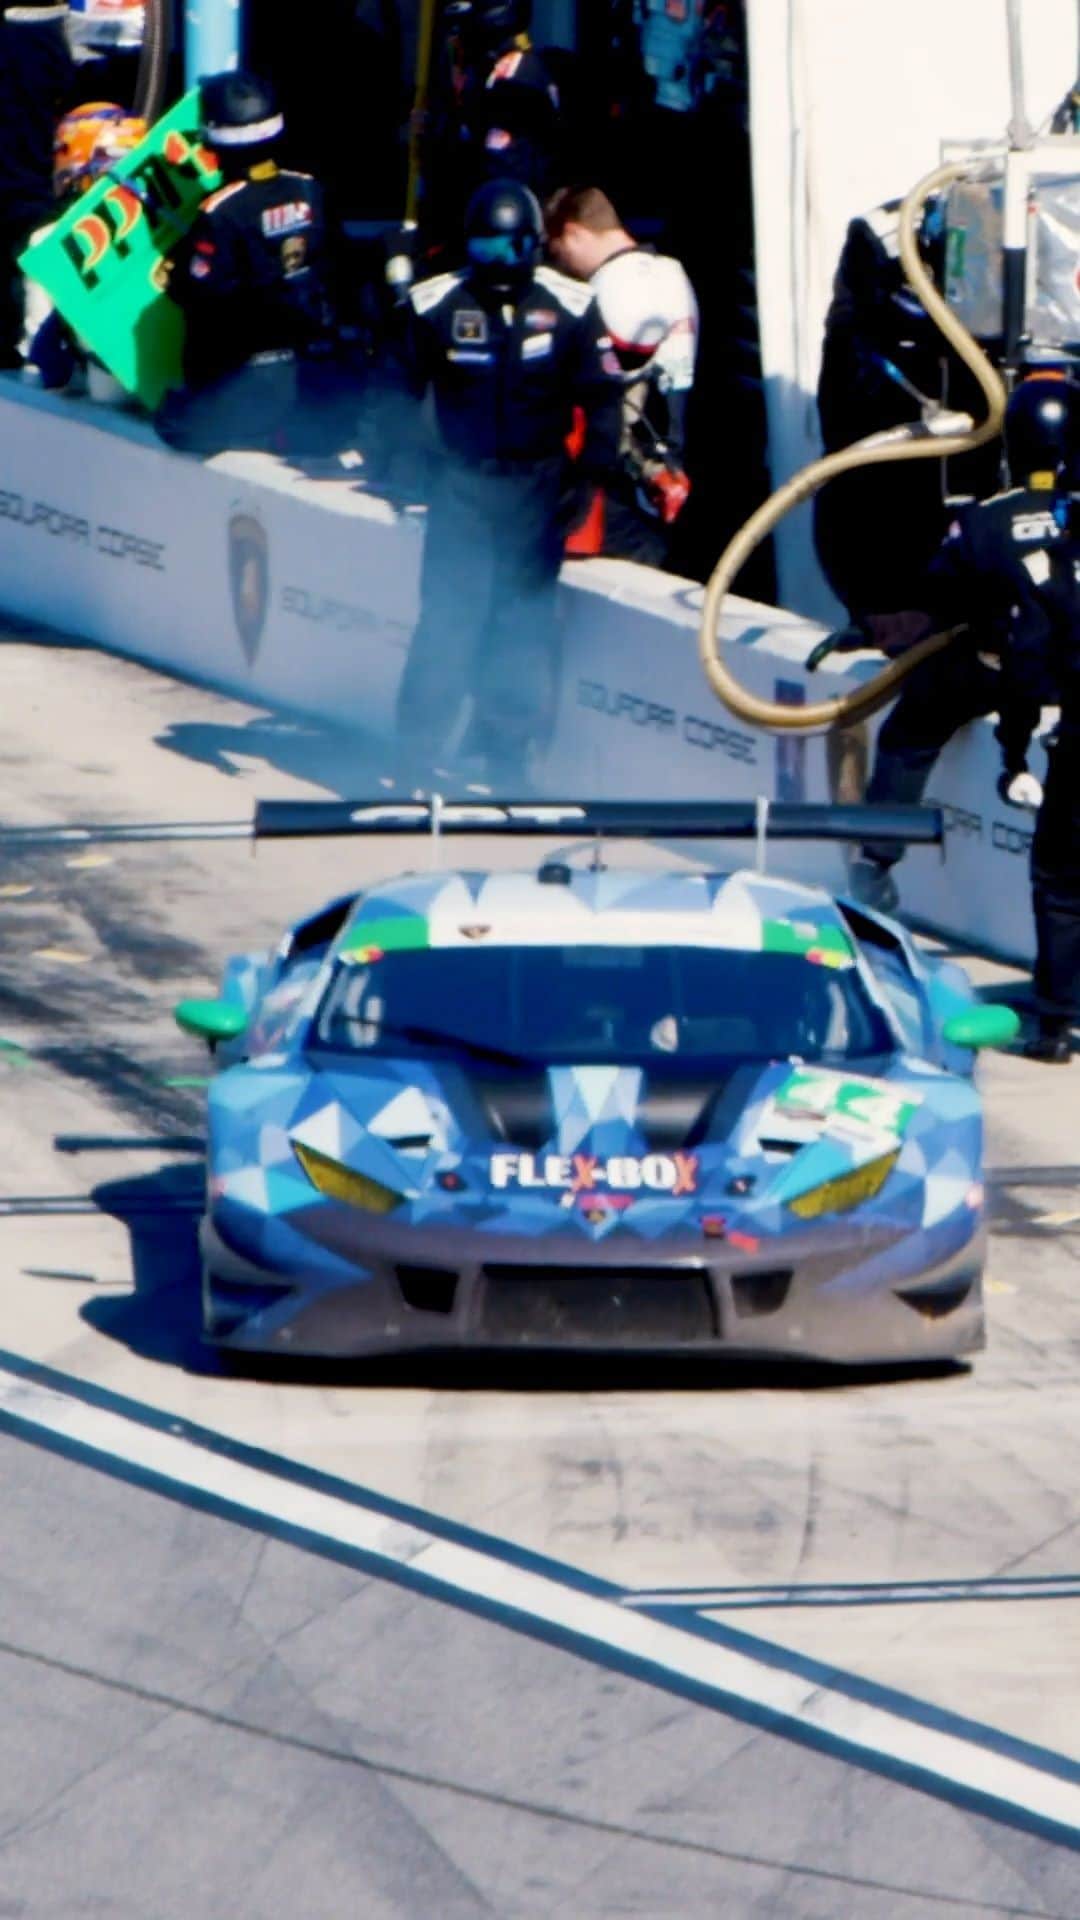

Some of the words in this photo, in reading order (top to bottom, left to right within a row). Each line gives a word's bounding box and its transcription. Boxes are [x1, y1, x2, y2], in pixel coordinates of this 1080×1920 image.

[683, 714, 758, 766] CORSE
[991, 821, 1034, 854] COR
[489, 1150, 698, 1197] FLEX-BOX
